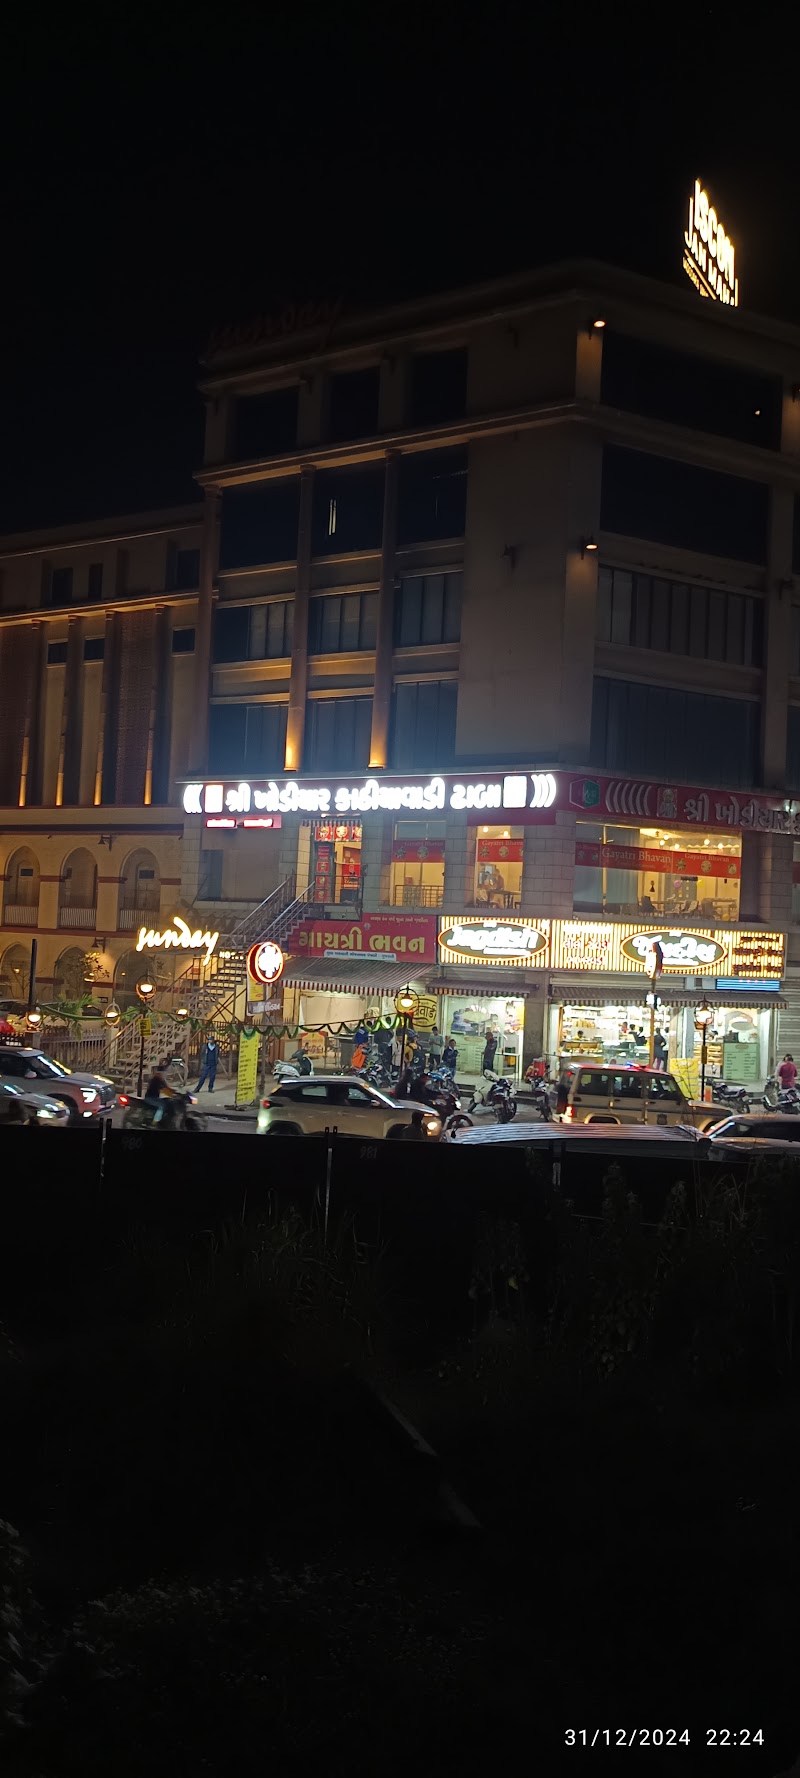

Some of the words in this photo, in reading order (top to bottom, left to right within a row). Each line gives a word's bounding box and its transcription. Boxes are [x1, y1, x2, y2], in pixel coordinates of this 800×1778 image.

[225, 782, 251, 812] શ્રી
[683, 793, 710, 822] શ્રી
[715, 796, 790, 830] ખોડીયાર
[481, 839, 504, 847] Gayatri
[602, 847, 636, 861] Gayatri
[638, 851, 672, 864] Bhavan
[684, 853, 707, 861] Gayatri
[136, 916, 220, 966] sunday
[298, 926, 362, 950] ગાયત્રી
[369, 934, 425, 954] ભવન
[359, 1146, 378, 1159] 981
